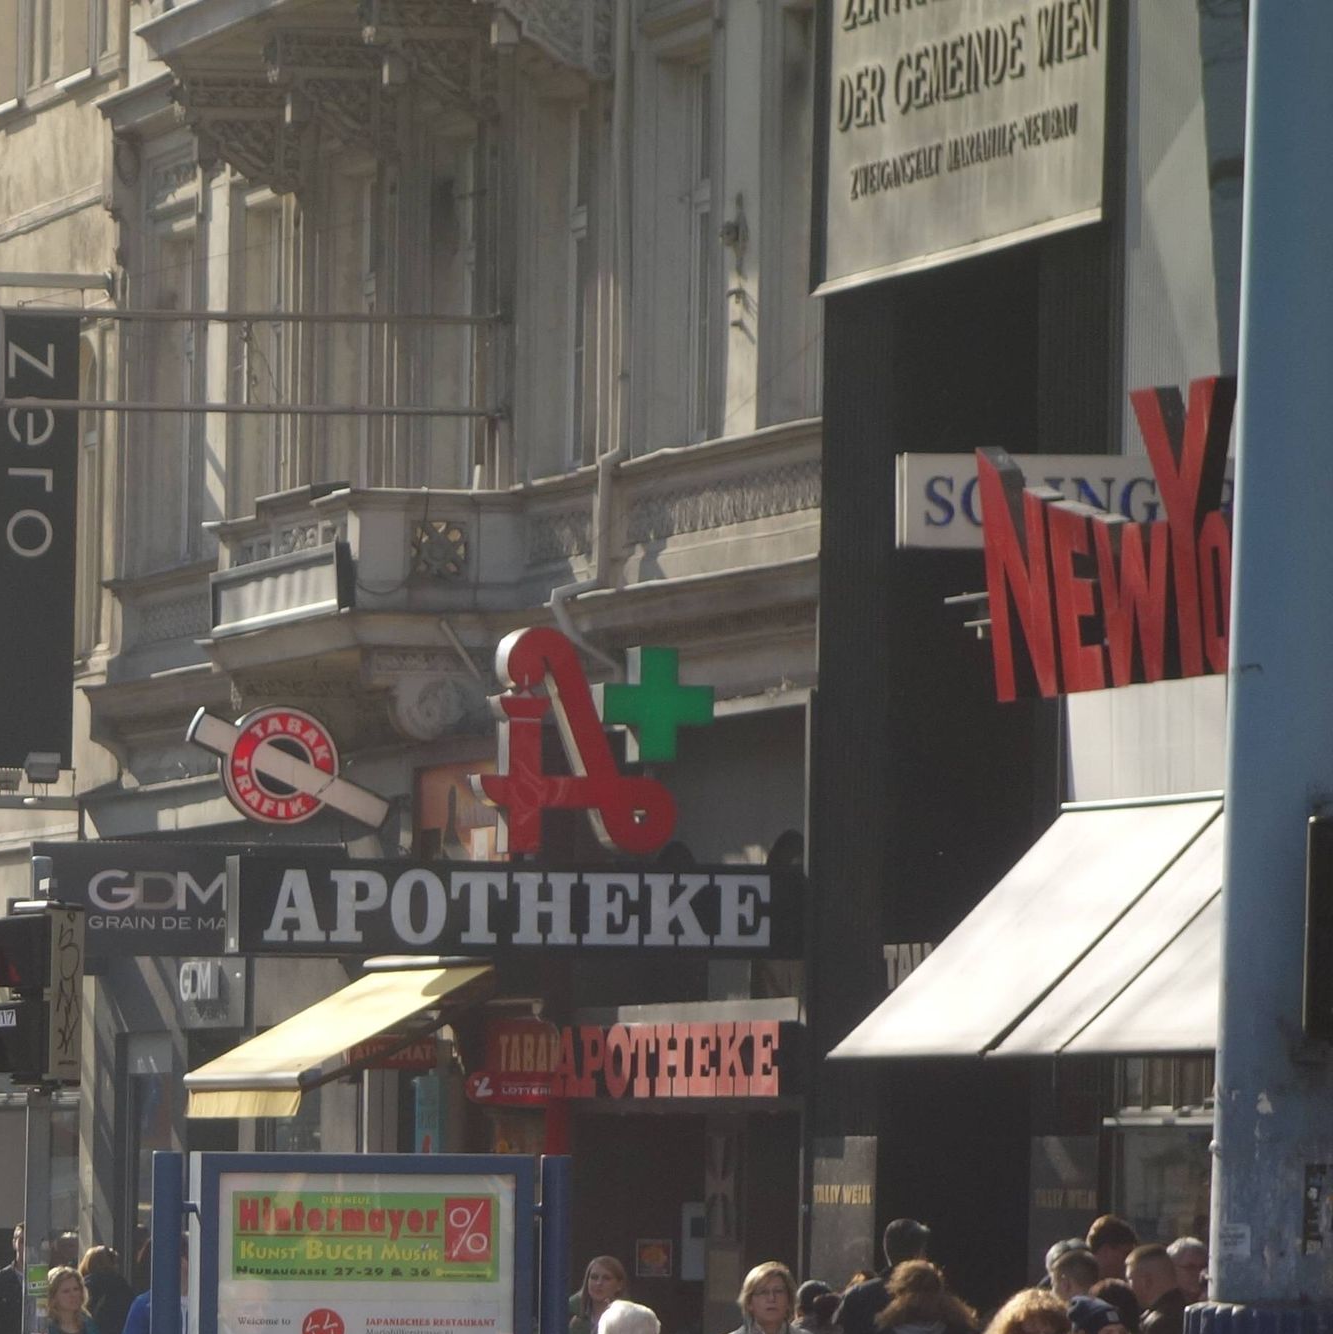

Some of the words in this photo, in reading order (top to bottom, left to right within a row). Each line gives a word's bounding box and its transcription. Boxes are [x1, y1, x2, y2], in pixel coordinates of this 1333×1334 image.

[837, 63, 887, 133] DER
[894, 14, 1027, 116] GEMEINDE
[1037, 0, 1100, 71] WIEN
[6, 341, 55, 558] zero
[250, 716, 332, 761] TABAK
[234, 757, 309, 817] TRAFIK
[88, 869, 227, 912] GDM
[262, 867, 772, 949] APOTHEKE
[88, 916, 156, 931] GRAIN
[162, 916, 192, 931] DE
[554, 1020, 780, 1099] APOTHEKE
[238, 1196, 439, 1241] Hintermayer
[333, 1266, 384, 1277] 27-29
[237, 1316, 280, 1326] Welcome
[281, 1317, 292, 1326] to
[365, 1317, 432, 1327] JAPANISCHES
[433, 1317, 496, 1327] RESTAURANT
